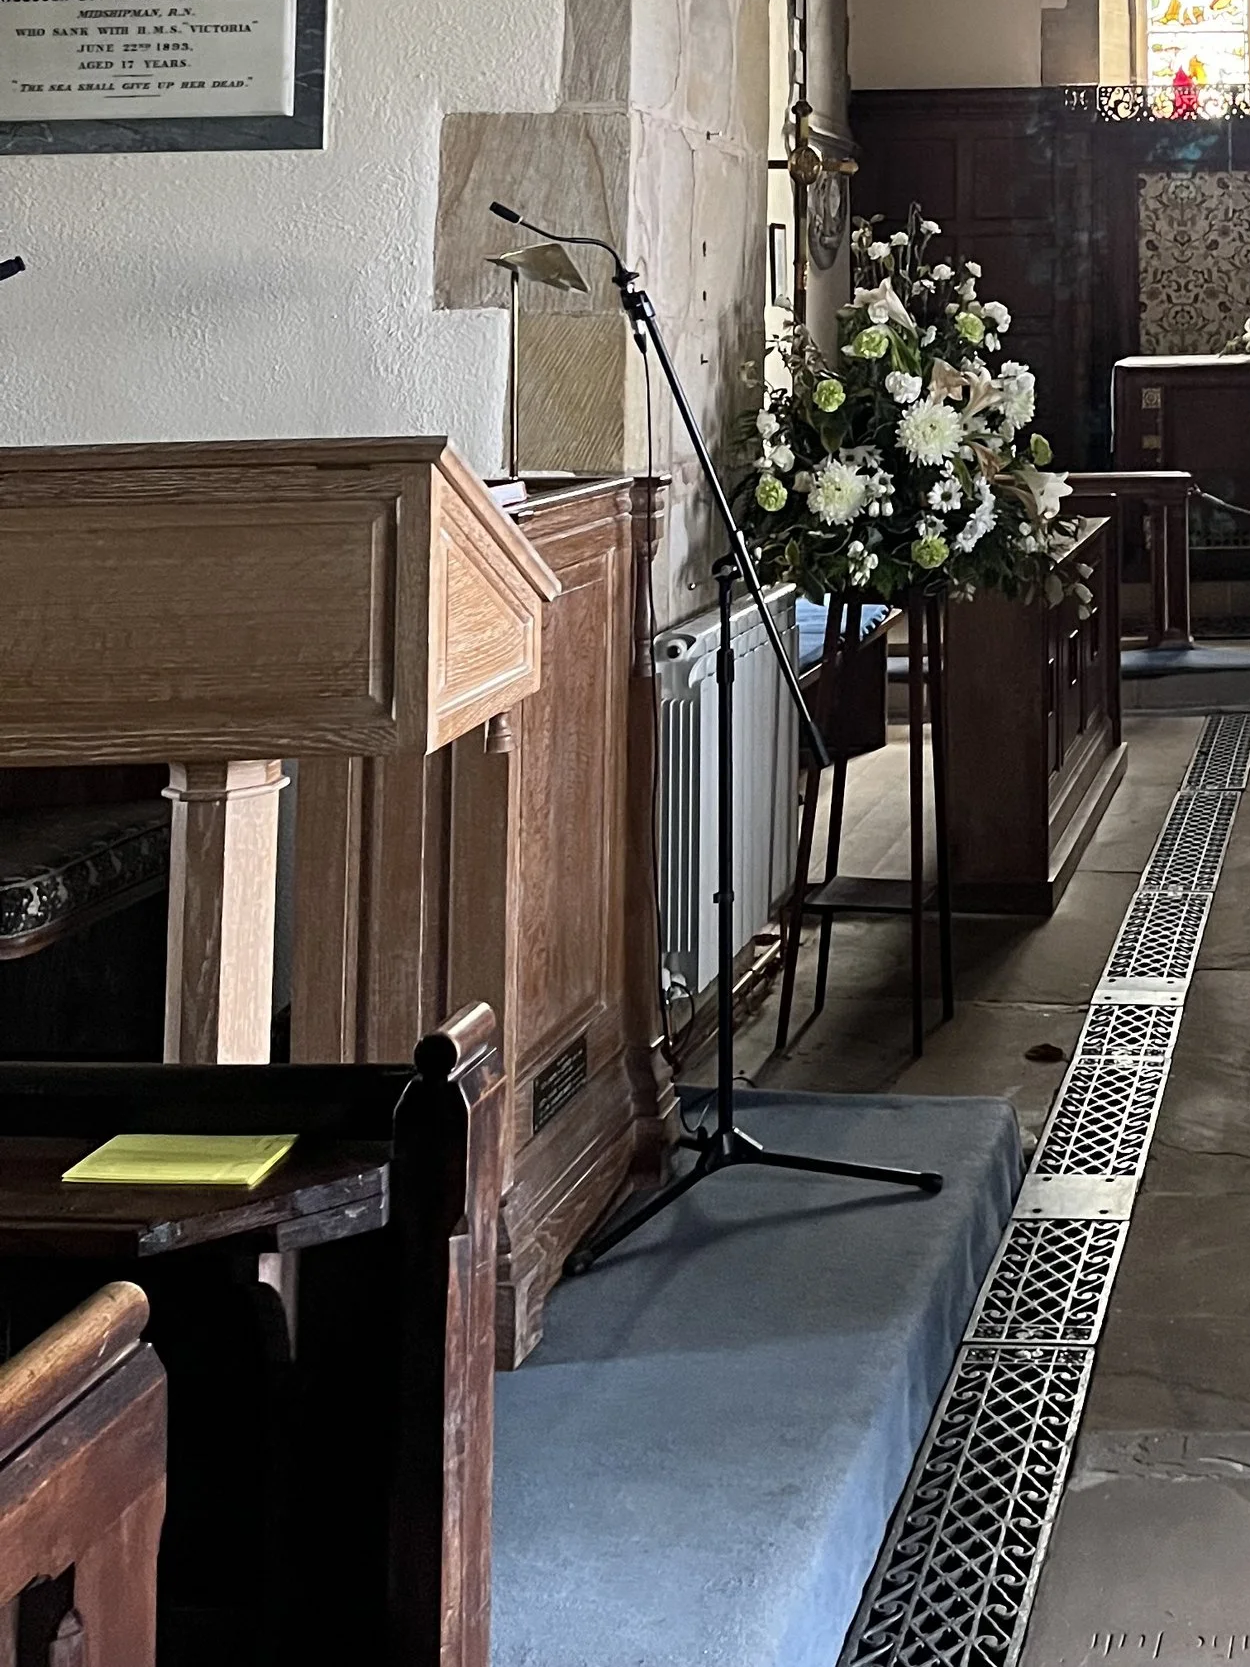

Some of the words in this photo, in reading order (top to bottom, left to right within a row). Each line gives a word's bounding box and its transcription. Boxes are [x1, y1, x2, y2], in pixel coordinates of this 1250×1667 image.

[15, 28, 45, 37] WHO
[52, 27, 88, 36] SANK
[97, 26, 129, 35] WITH
[76, 43, 114, 53] JUNE
[78, 60, 114, 70] AGED
[121, 60, 134, 69] 17
[48, 84, 72, 92] SEA
[77, 82, 115, 92] SHALL
[121, 82, 151, 90] GIVE
[157, 81, 175, 90] UP
[180, 80, 206, 89] HER
